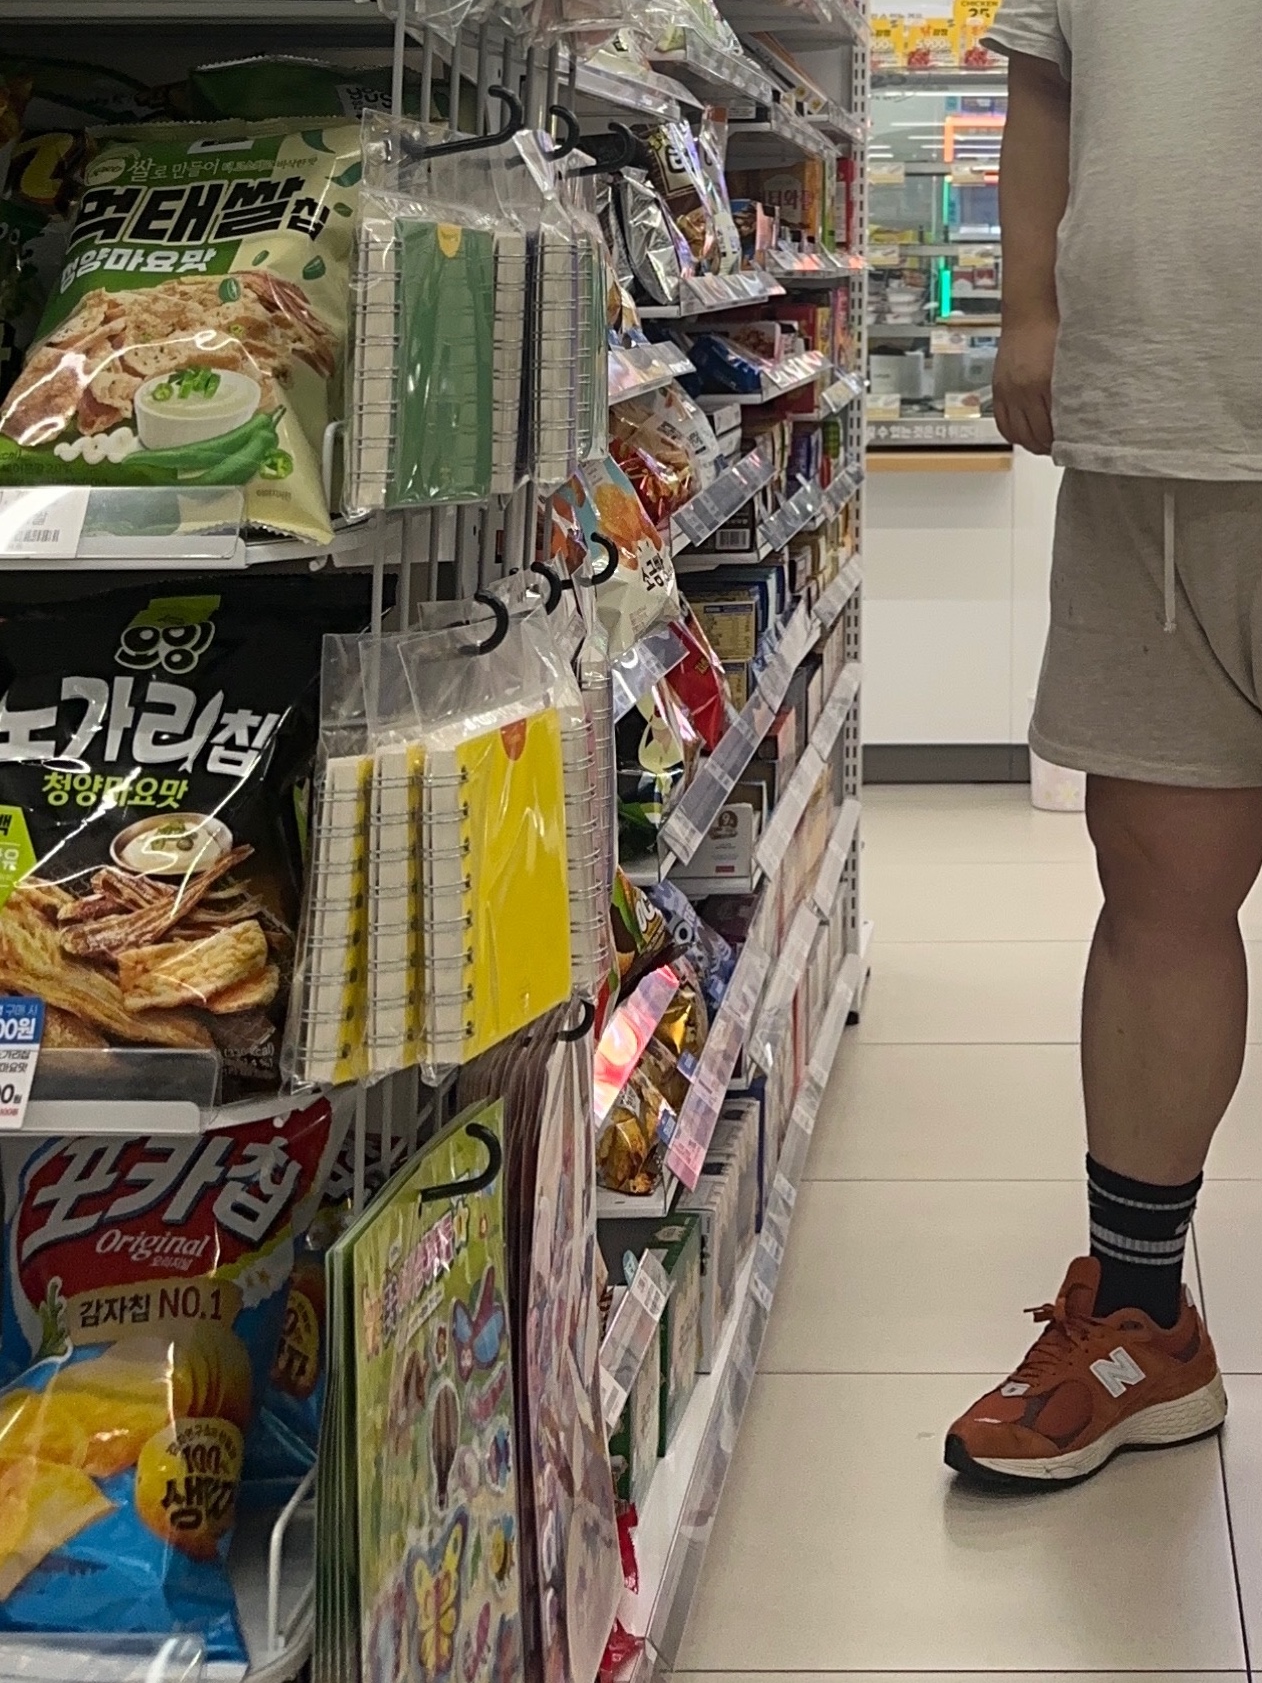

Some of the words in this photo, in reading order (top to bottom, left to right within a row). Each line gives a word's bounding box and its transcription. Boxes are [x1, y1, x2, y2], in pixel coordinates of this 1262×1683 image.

[129, 158, 168, 183] 쌀로
[172, 158, 220, 180] 만들어
[0, 675, 280, 777] 노가리칩
[43, 771, 189, 808] 청양마요맛
[22, 1133, 302, 1244] 포카칩
[96, 1228, 210, 1265] Original
[79, 1294, 151, 1328] 감자칩
[159, 1288, 222, 1322] NO.1
[1091, 1346, 1146, 1398] N
